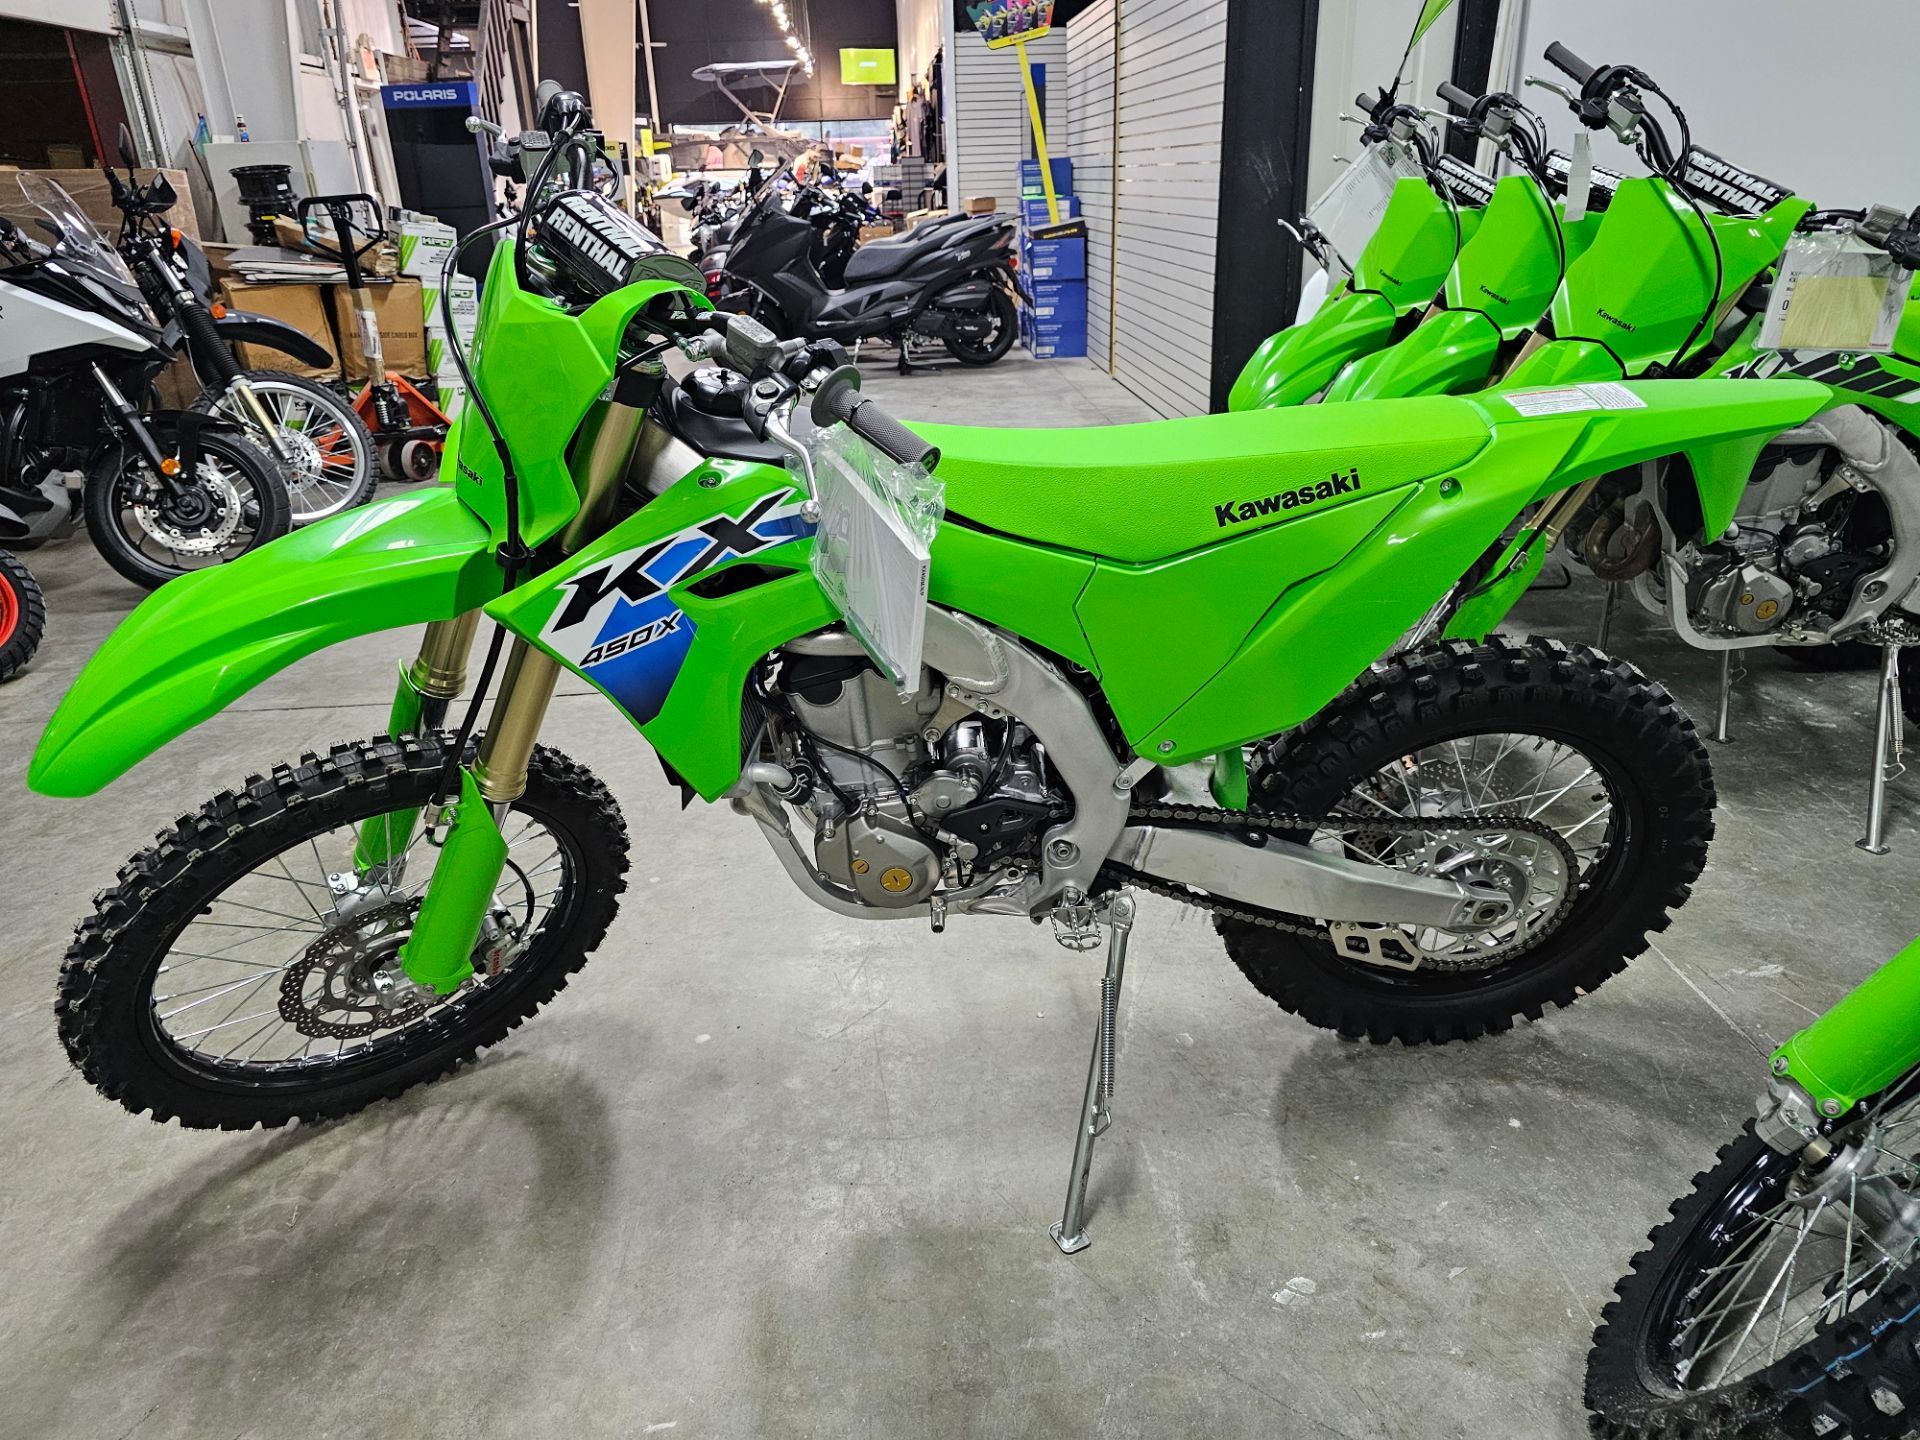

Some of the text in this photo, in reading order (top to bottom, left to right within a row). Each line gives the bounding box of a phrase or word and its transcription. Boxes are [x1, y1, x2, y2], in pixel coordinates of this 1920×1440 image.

[393, 89, 457, 101] POLARIS
[547, 206, 628, 282] RENTHAL
[1479, 284, 1510, 305] Kawasaki
[1596, 307, 1636, 334] Kawasaki
[1214, 468, 1361, 527] Kawasaki
[550, 488, 792, 633] KX
[579, 611, 683, 668] 450X
